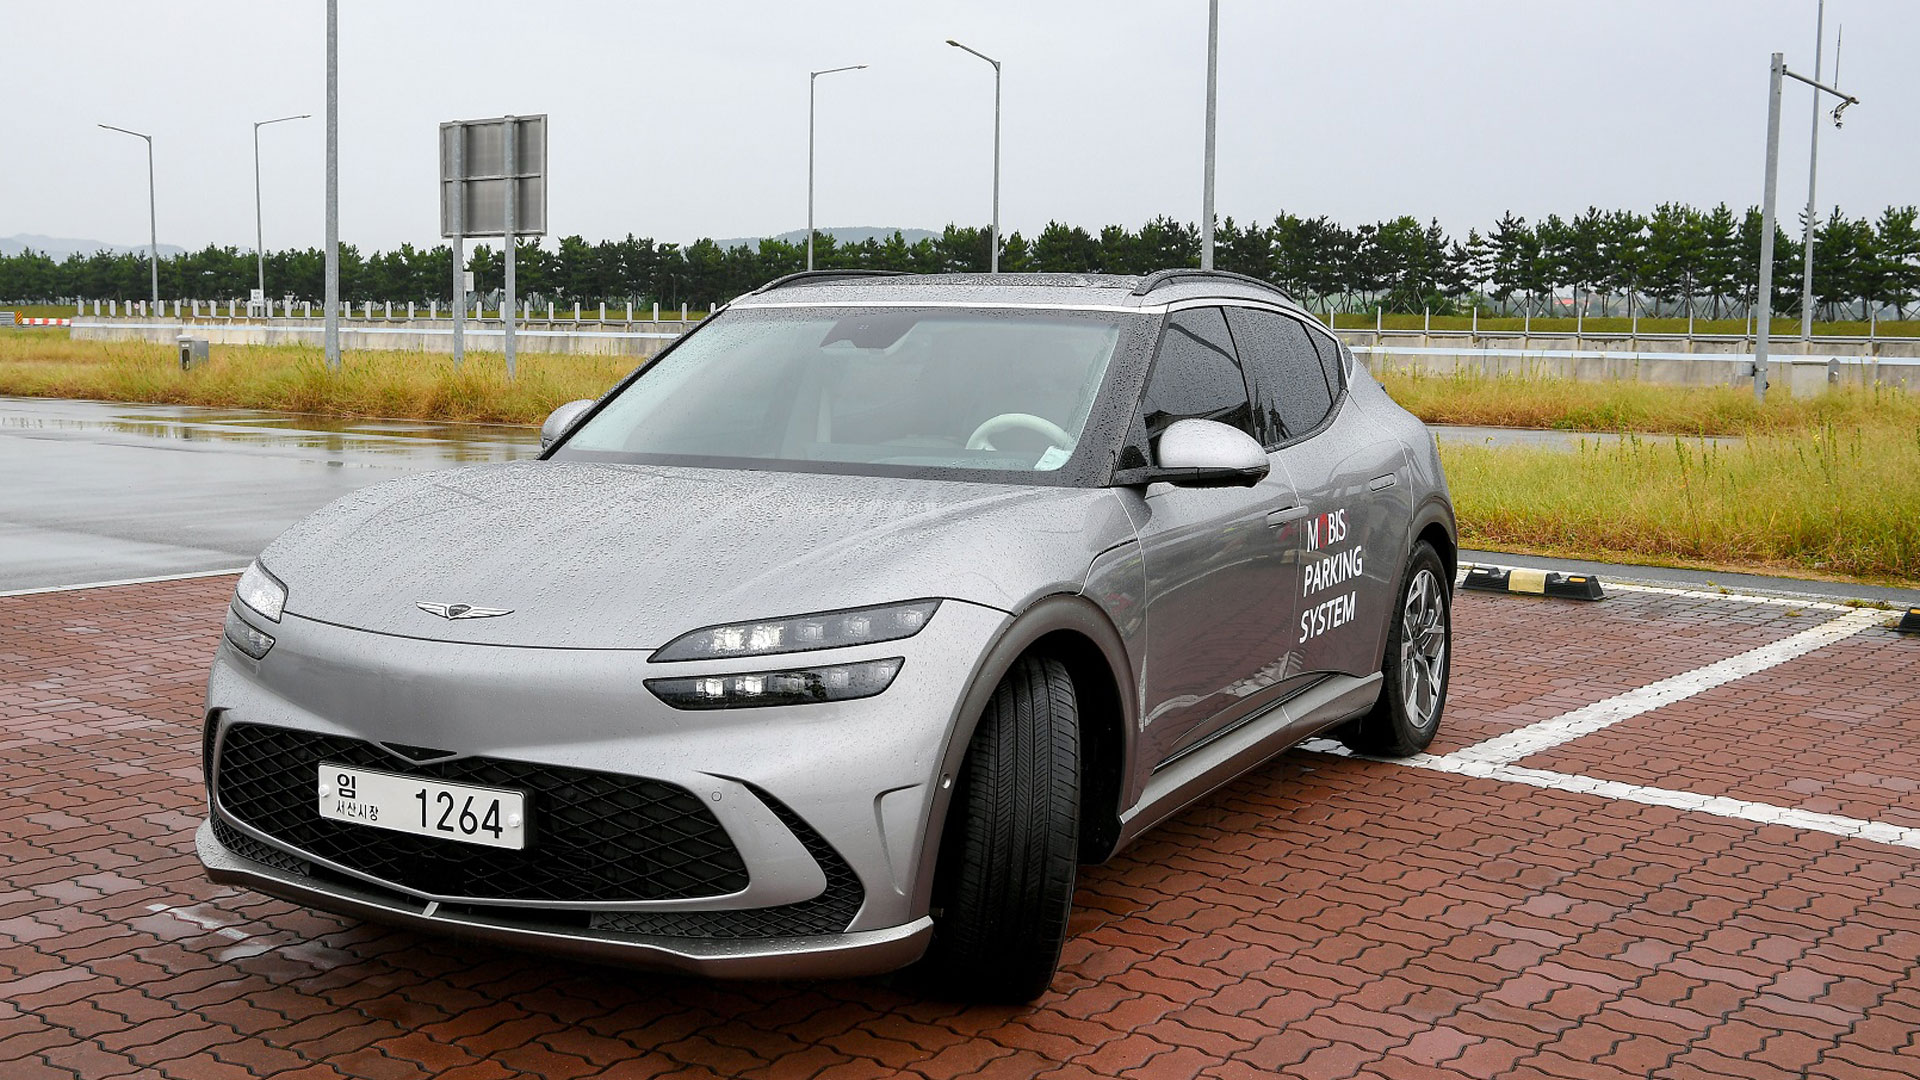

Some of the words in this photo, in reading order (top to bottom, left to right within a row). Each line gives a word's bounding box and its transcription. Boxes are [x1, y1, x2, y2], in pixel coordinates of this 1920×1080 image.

[1307, 508, 1346, 552] MOBIS
[1303, 545, 1363, 597] PARKING
[1299, 591, 1356, 643] SYSTEM
[336, 773, 356, 799] 임
[336, 800, 379, 821] 서산시장
[415, 788, 503, 839] 1264
